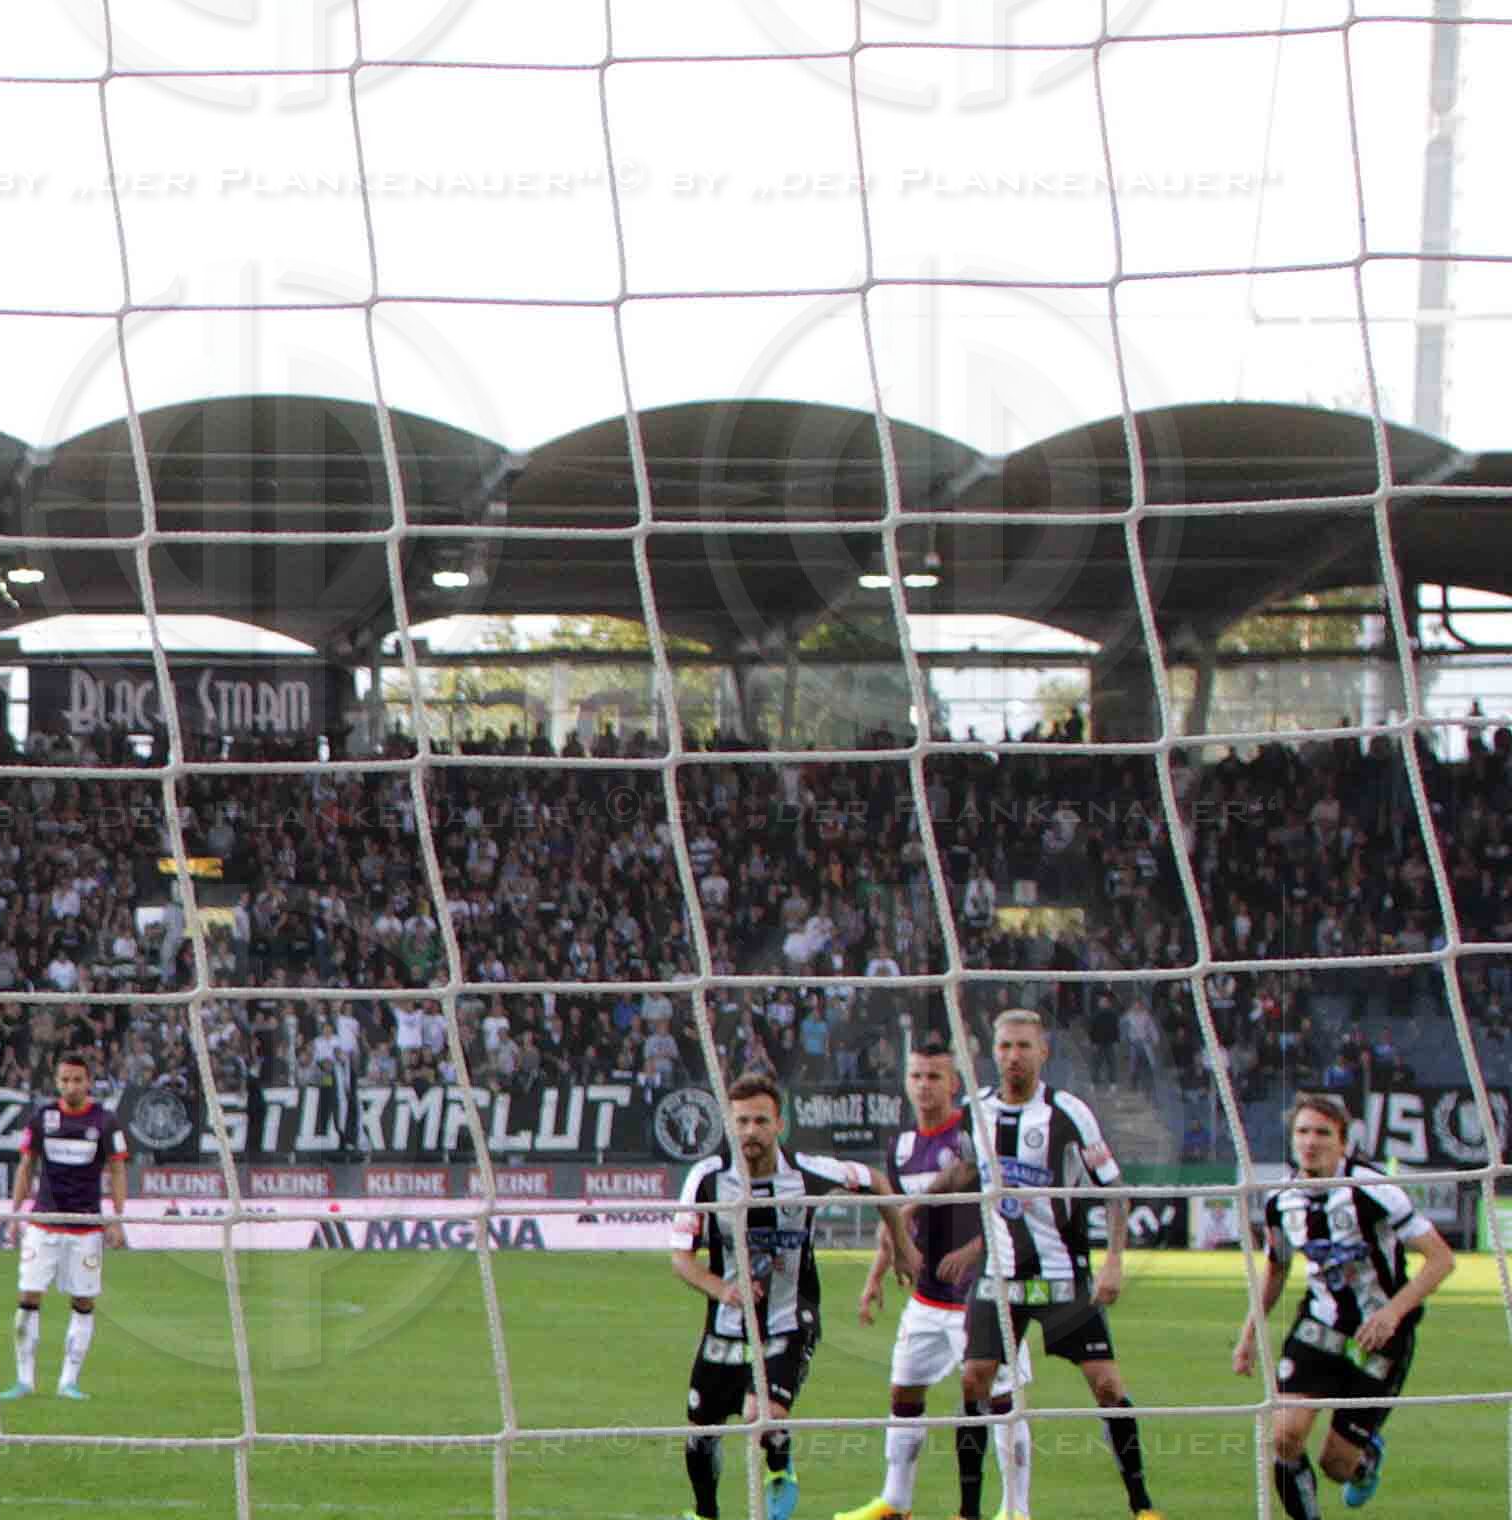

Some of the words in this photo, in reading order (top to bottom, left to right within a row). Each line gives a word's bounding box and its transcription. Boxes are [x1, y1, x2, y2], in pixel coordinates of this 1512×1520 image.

[144, 1171, 222, 1195] KLEINE
[251, 1171, 327, 1195] KLEINE
[367, 1171, 446, 1195] KLEINE
[587, 1171, 663, 1195] KLEINE
[367, 1217, 545, 1249] MAGNA
